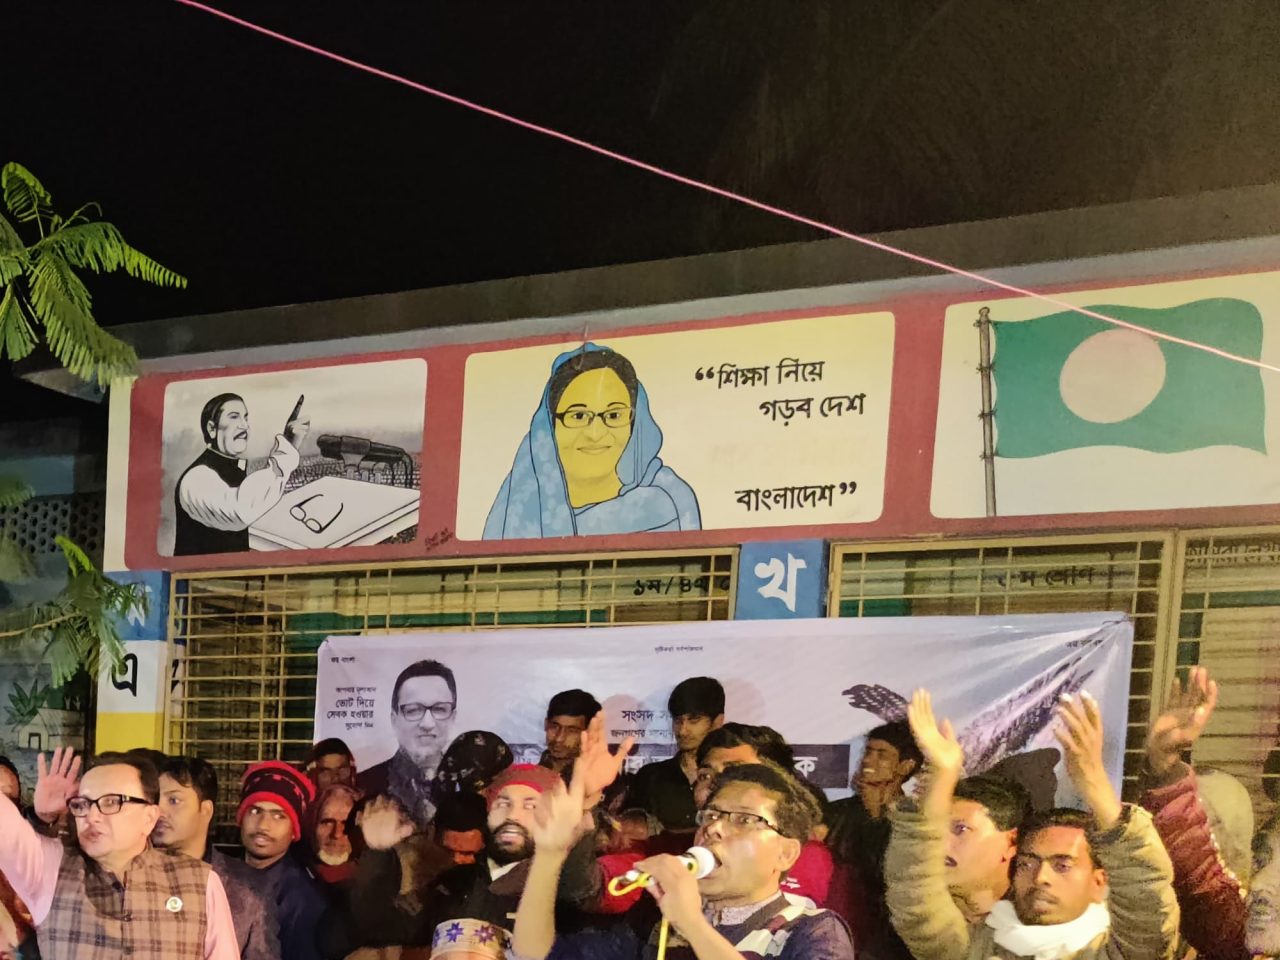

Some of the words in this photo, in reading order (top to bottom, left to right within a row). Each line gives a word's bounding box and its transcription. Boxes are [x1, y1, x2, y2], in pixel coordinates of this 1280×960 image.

[776, 357, 825, 384] নিয়ে
[759, 397, 814, 426] গড়ব
[820, 393, 866, 417] দেশ
[754, 552, 807, 613] খ
[336, 697, 355, 708] ভোট
[327, 710, 348, 719] সেবক
[621, 709, 654, 722] সংসদ
